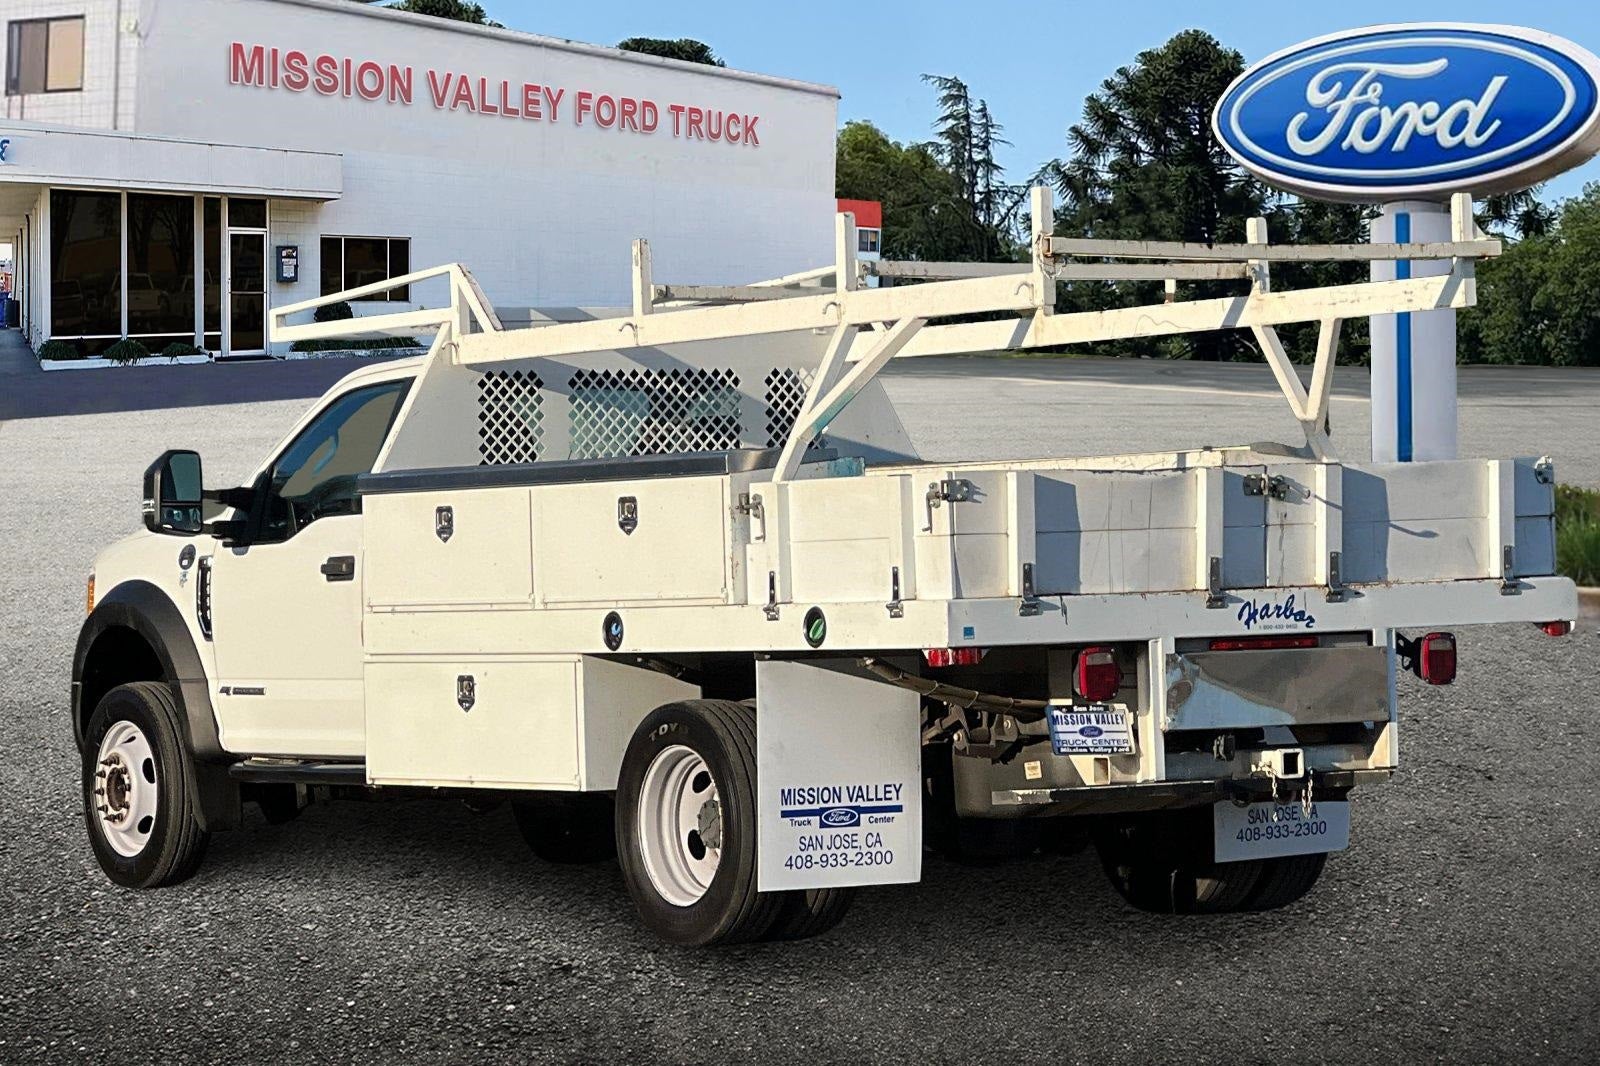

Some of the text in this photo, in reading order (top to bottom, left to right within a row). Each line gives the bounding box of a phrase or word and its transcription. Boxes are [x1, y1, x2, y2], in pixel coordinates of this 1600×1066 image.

[230, 41, 760, 146] MISSION VALLEY FORD TRUCK
[1286, 57, 1509, 156] Ford
[1238, 593, 1316, 630] Harbor
[1051, 714, 1125, 725] MISSION VALLEY
[781, 783, 903, 806] MISSION VALLEY
[790, 818, 812, 827] Truck
[828, 810, 851, 822] Ford
[868, 815, 895, 824] Center
[1248, 808, 1269, 825] SAN
[1236, 820, 1327, 842] 408-933-2300
[798, 832, 883, 852] SAN JOSE, CA
[784, 850, 894, 870] 408-933-2300
